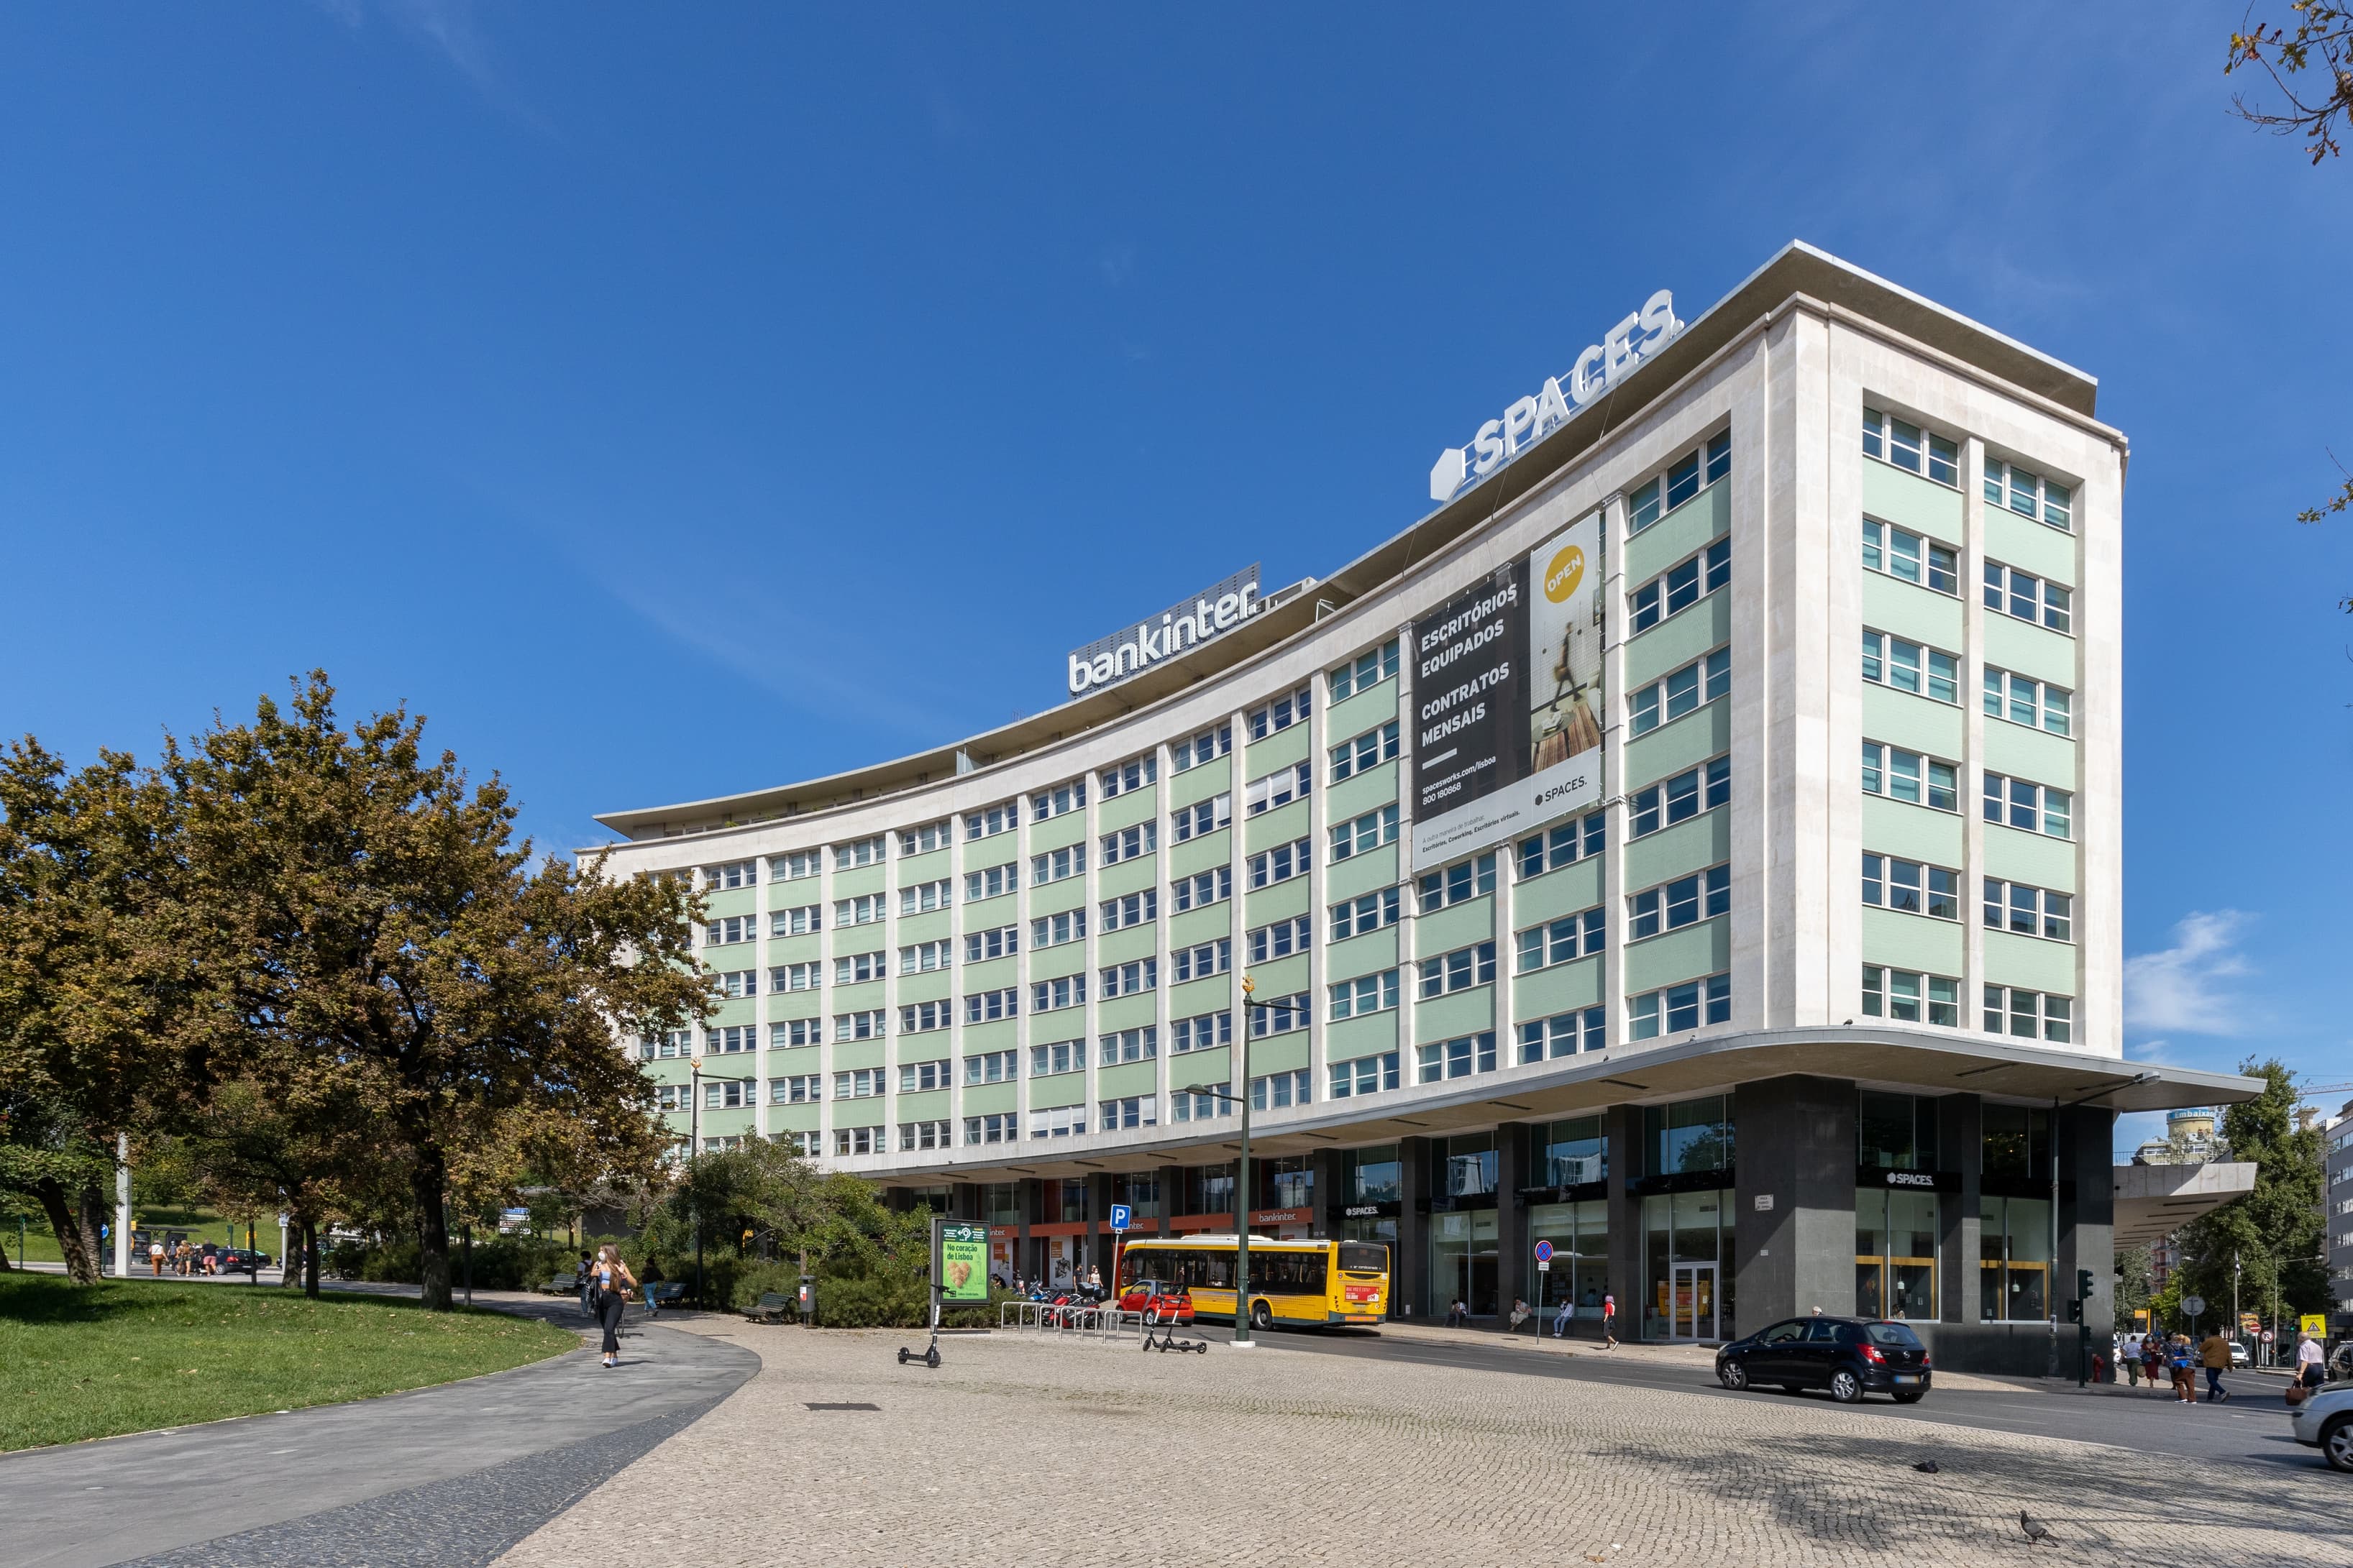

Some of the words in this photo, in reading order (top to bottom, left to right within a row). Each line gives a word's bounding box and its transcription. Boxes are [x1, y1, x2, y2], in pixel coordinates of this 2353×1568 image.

[1547, 554, 1581, 592] OPEN
[1421, 583, 1517, 652] ESCRITÓRIOS
[1421, 618, 1504, 679] EQUIPADOS
[1422, 661, 1510, 720] CONTRATOS
[1422, 702, 1486, 747] MENSAIS
[1422, 756, 1497, 795] spacesworks.com/lisboa
[1545, 776, 1588, 802] SPACES.
[1422, 793, 1436, 806] 800
[1474, 818, 1500, 833] Escritórios
[1115, 1209, 1126, 1224] P
[956, 1244, 978, 1254] coração
